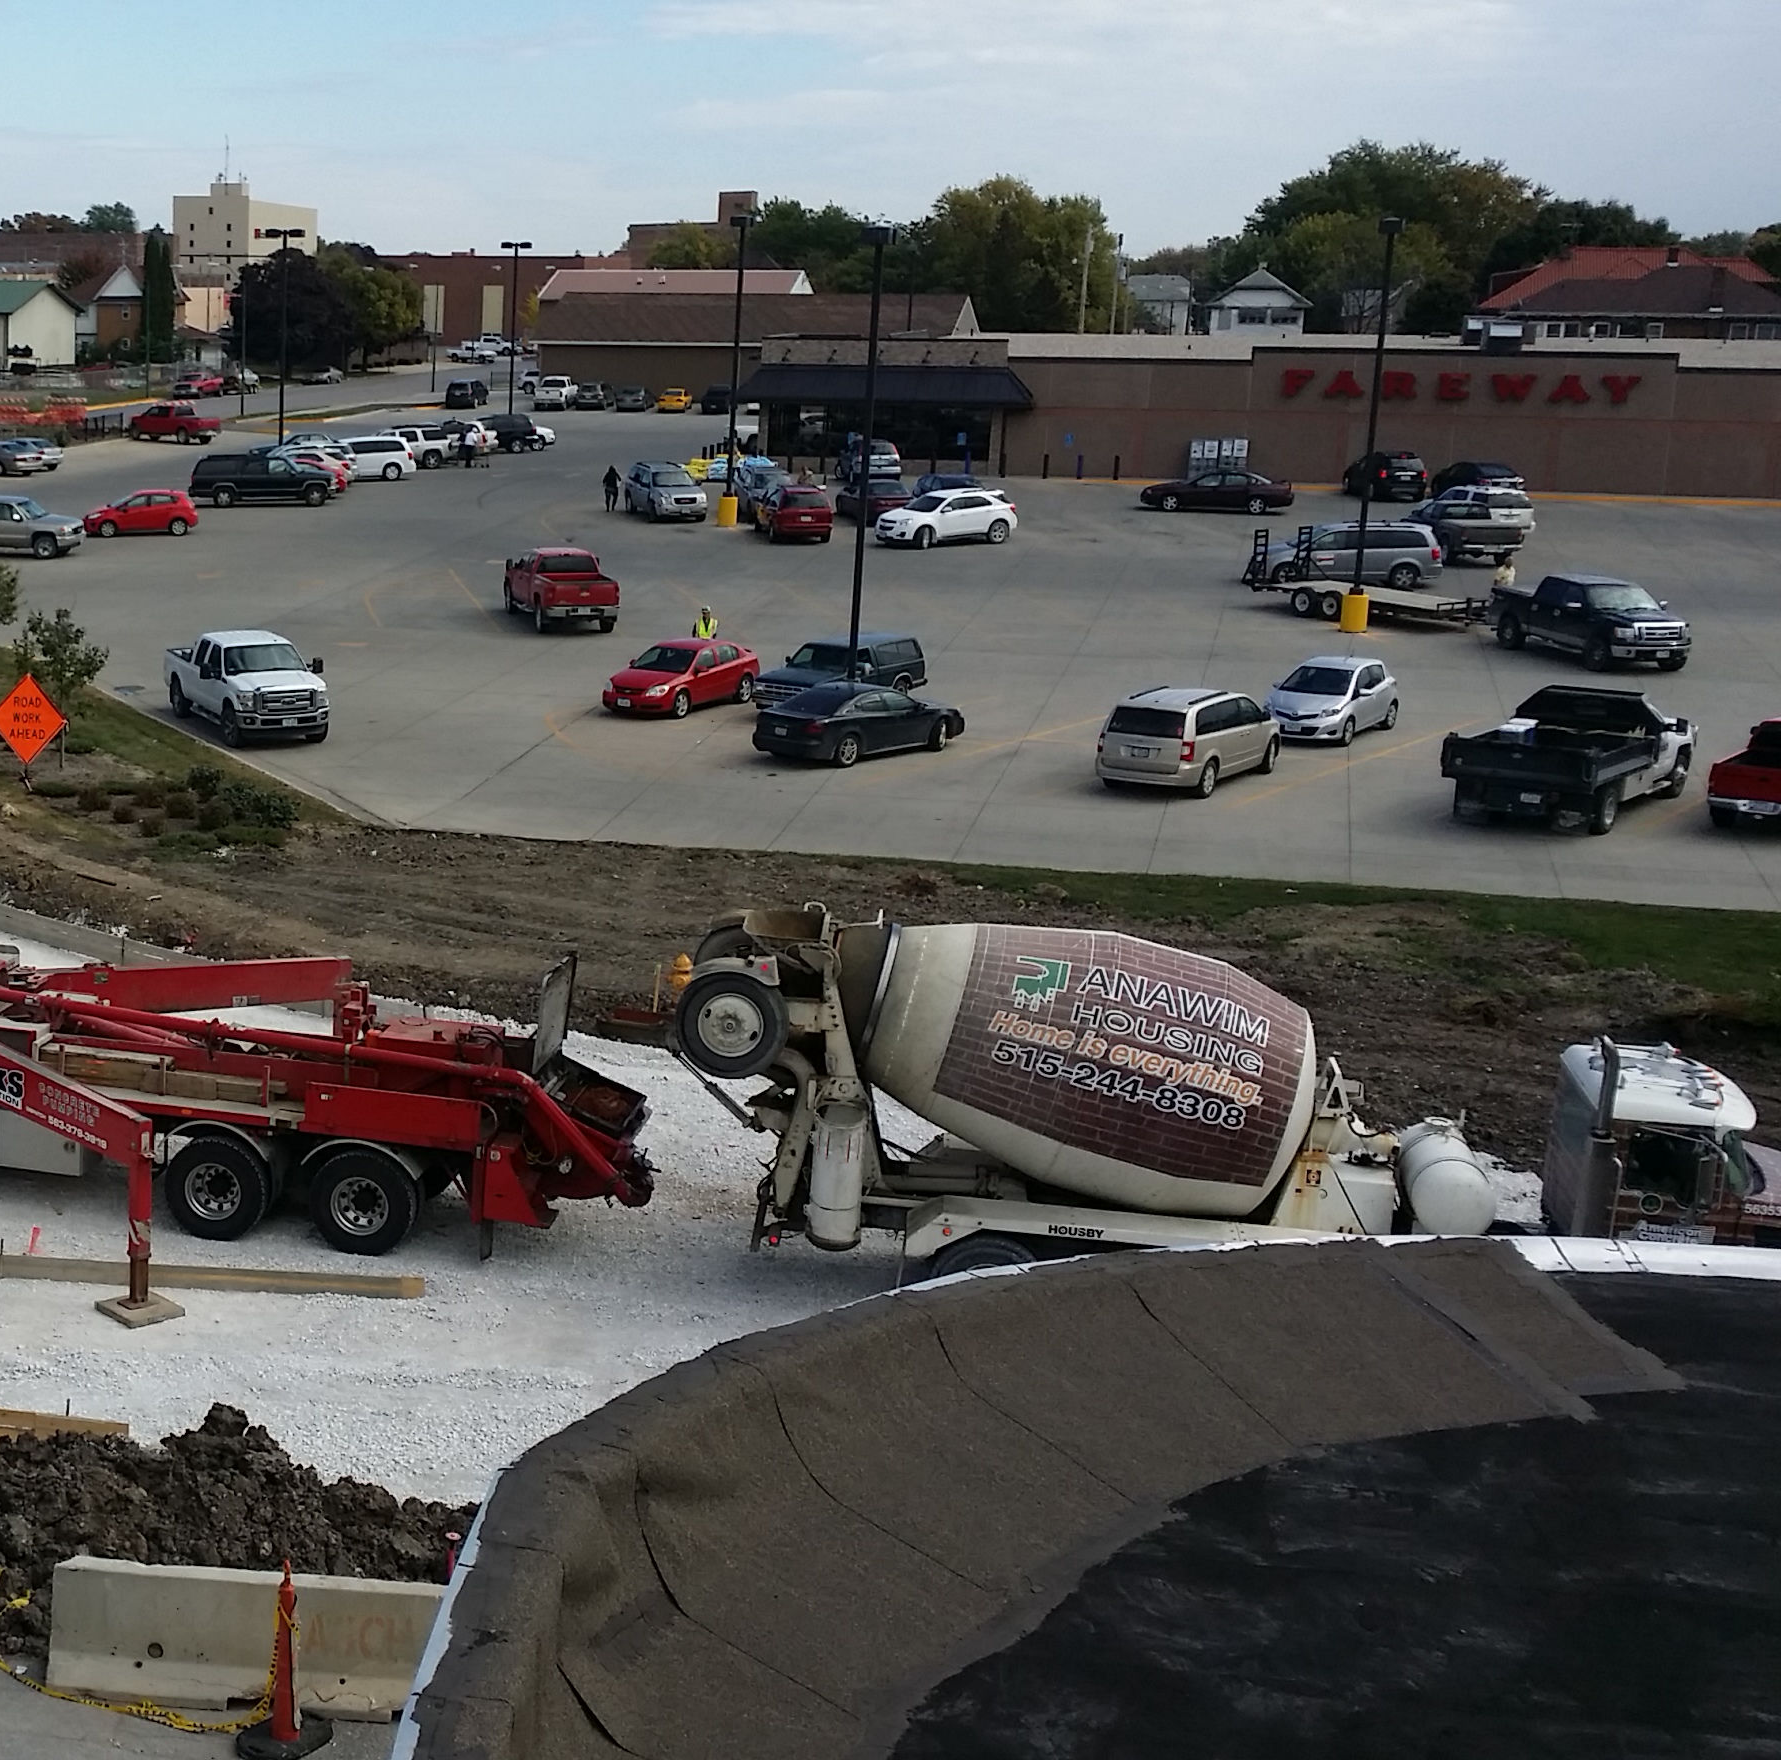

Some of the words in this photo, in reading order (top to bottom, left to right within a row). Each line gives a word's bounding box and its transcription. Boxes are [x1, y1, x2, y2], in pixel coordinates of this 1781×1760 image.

[1281, 369, 1642, 403] FAREWAY
[13, 696, 42, 708] ROAD
[13, 712, 41, 723] WORK
[9, 728, 46, 740] AHEAD
[1076, 966, 1271, 1047] ANAWIM
[1070, 1002, 1264, 1077] HOUSING
[987, 1010, 1075, 1050] Home
[1076, 1029, 1109, 1060] is
[1110, 1045, 1265, 1106] everything.
[38, 1082, 101, 1118] CONCRETE
[991, 1039, 1246, 1130] 515-244-8308
[42, 1095, 96, 1127] PUMPING
[1048, 1224, 1105, 1239] HOUSBY
[1638, 1220, 1702, 1237] American
[1638, 1231, 1699, 1244] Concrete
